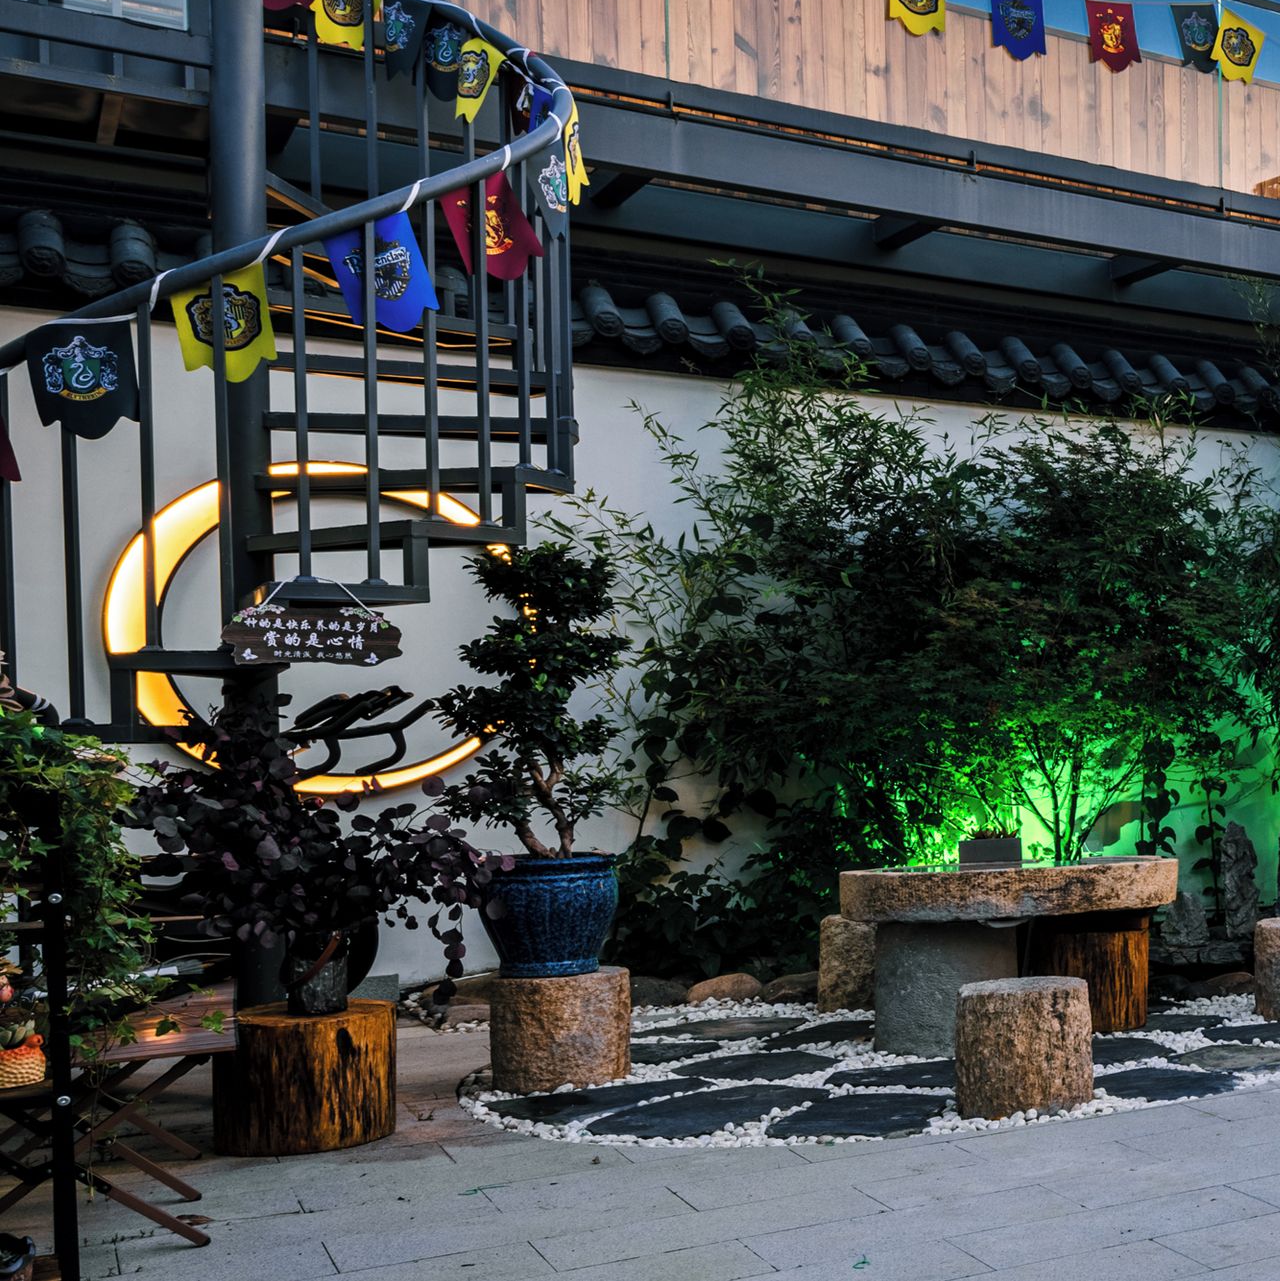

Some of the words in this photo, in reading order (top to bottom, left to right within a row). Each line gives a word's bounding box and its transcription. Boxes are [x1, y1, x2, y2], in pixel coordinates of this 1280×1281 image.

[244, 617, 311, 630] 种的是快乐
[316, 620, 380, 633] 养的是岁月
[263, 630, 365, 650] 赏的是心情
